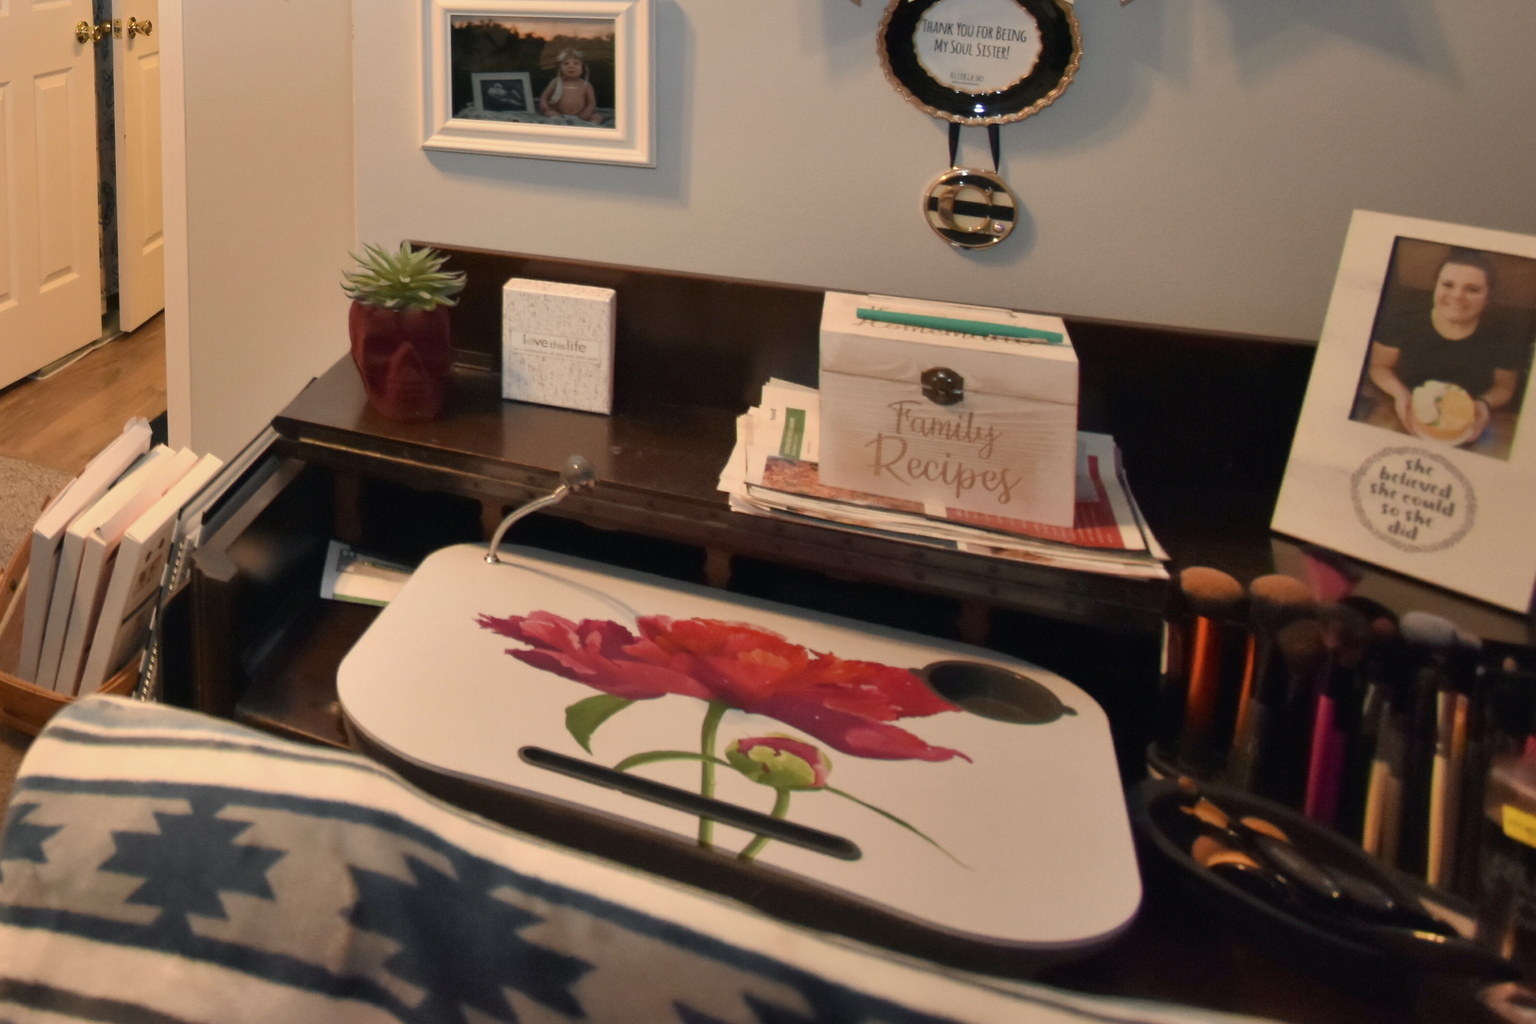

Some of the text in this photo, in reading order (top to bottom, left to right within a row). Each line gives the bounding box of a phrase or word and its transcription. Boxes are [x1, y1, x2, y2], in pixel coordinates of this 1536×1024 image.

[923, 19, 1027, 43] THANK YOU FOR BEING
[934, 39, 1010, 60] MY SOUL SISTER!
[523, 334, 586, 353] love this life
[887, 400, 1002, 459] Family
[865, 433, 1022, 505] Recipes
[1406, 458, 1433, 476] she
[1379, 465, 1453, 499] believed
[1370, 482, 1455, 517] she could
[1382, 503, 1432, 527] so she
[1387, 521, 1418, 541] did
